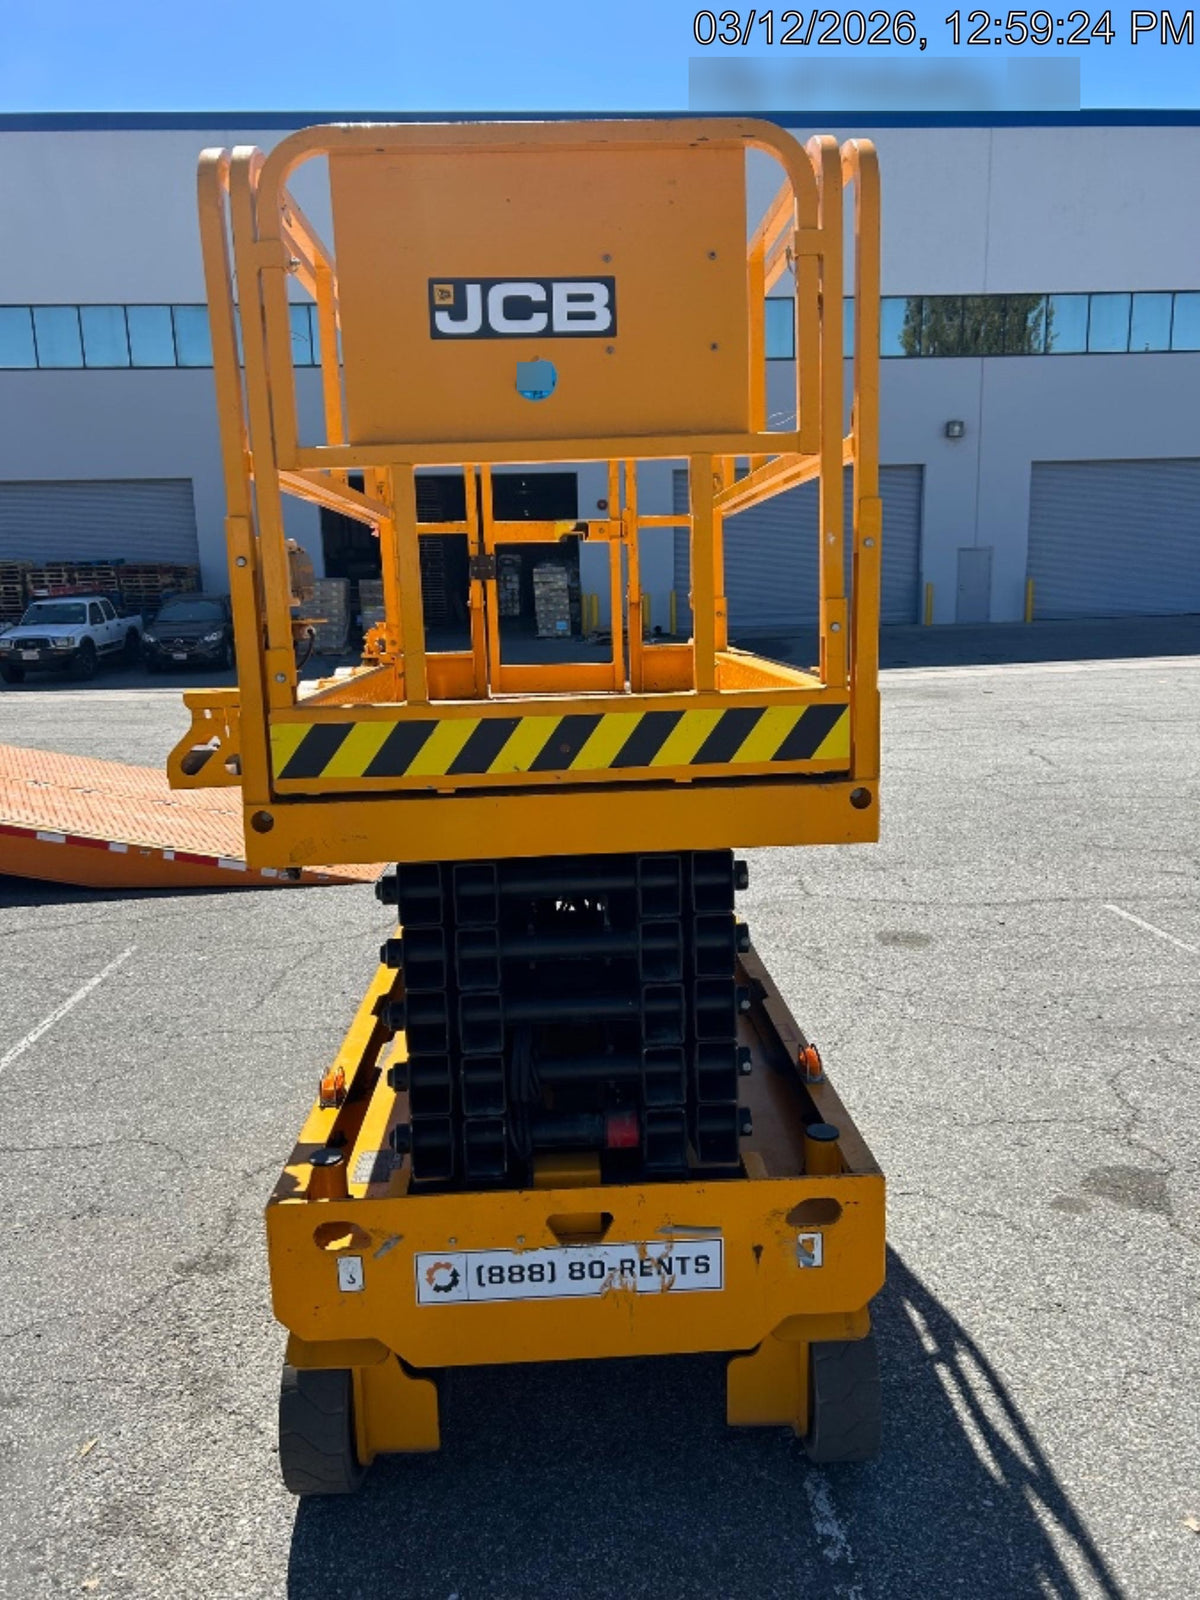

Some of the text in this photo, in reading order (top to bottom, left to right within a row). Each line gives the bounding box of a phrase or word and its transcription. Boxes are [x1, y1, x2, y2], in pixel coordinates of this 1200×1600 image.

[434, 282, 612, 334] JCB
[476, 1254, 711, 1287] (888) 80-RENTS
